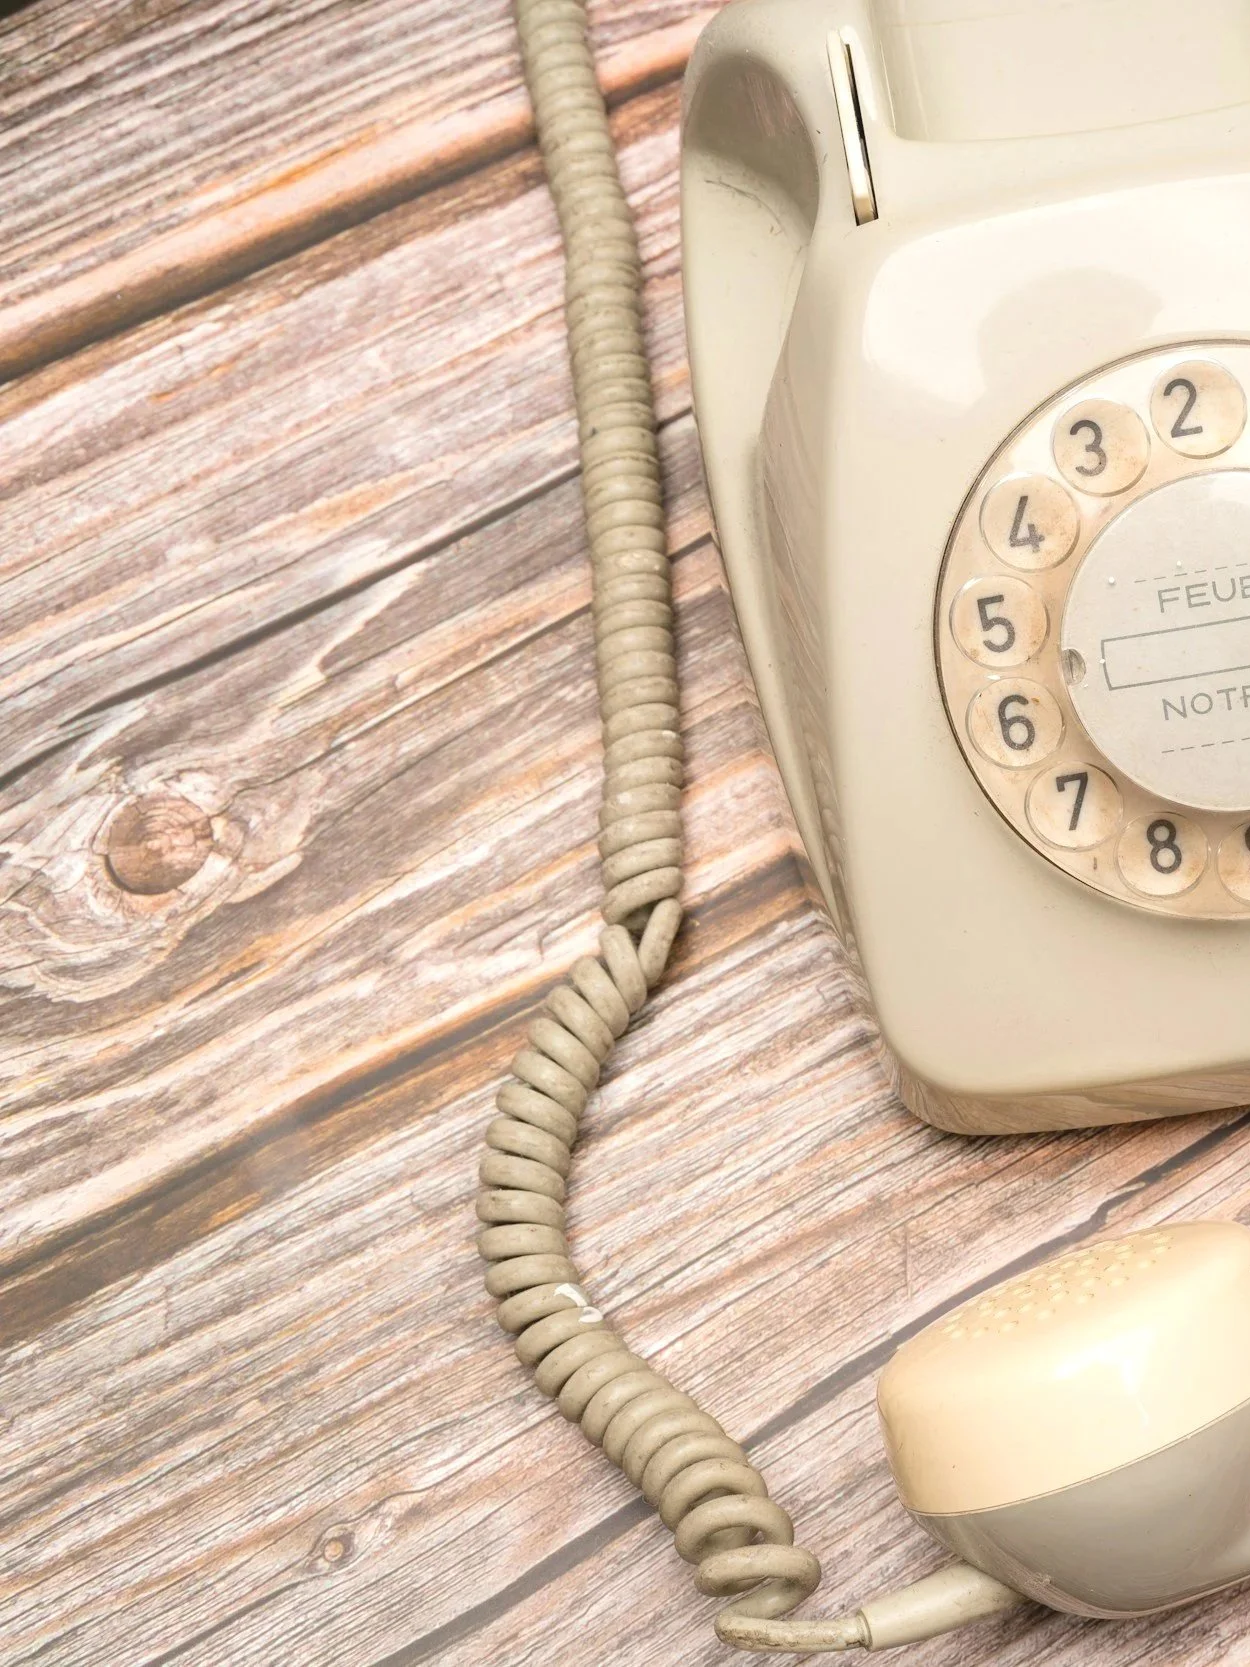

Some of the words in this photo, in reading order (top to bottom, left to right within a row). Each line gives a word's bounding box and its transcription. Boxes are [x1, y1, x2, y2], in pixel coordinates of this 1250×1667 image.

[1162, 378, 1203, 439] 2
[1069, 418, 1107, 477] 3
[1008, 495, 1045, 553] 4
[977, 594, 1016, 653] 5
[997, 695, 1036, 751] 6
[1056, 771, 1090, 831] 7
[1145, 818, 1183, 874] 8
